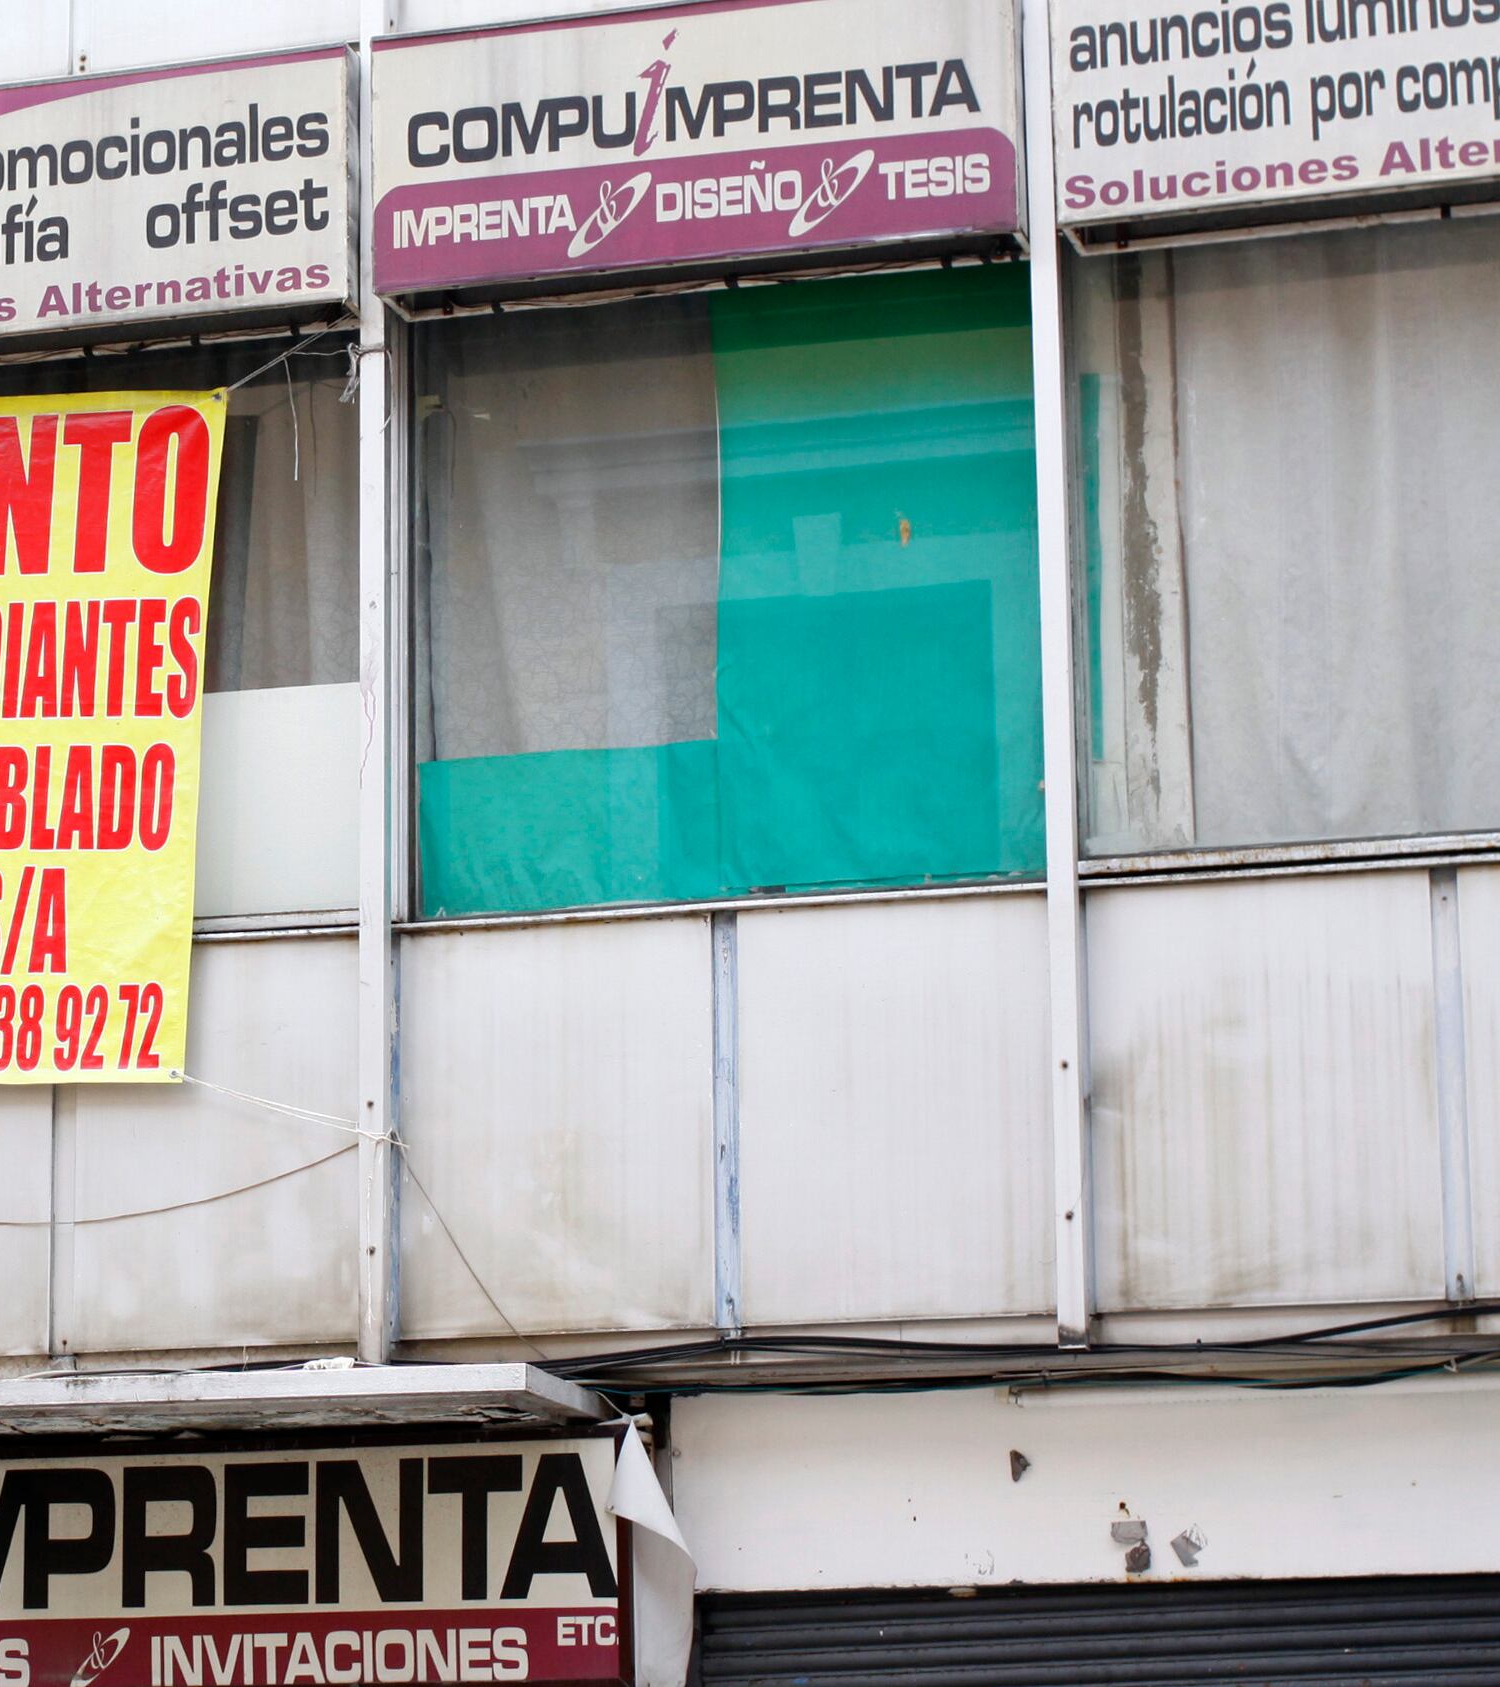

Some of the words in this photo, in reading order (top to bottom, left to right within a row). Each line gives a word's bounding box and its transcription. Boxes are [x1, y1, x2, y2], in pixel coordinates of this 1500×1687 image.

[1069, 0, 1293, 73] anuncios
[1072, 57, 1292, 149] rotulación
[1310, 68, 1386, 141] por
[145, 178, 330, 250] offset
[392, 194, 577, 249] IMPRENTA
[655, 160, 803, 223] DISEÑO
[878, 152, 991, 200] TESIS
[1064, 155, 1360, 210] Soluciones
[37, 261, 331, 319] Alternativas
[150, 1627, 529, 1687] INVITACIONES
